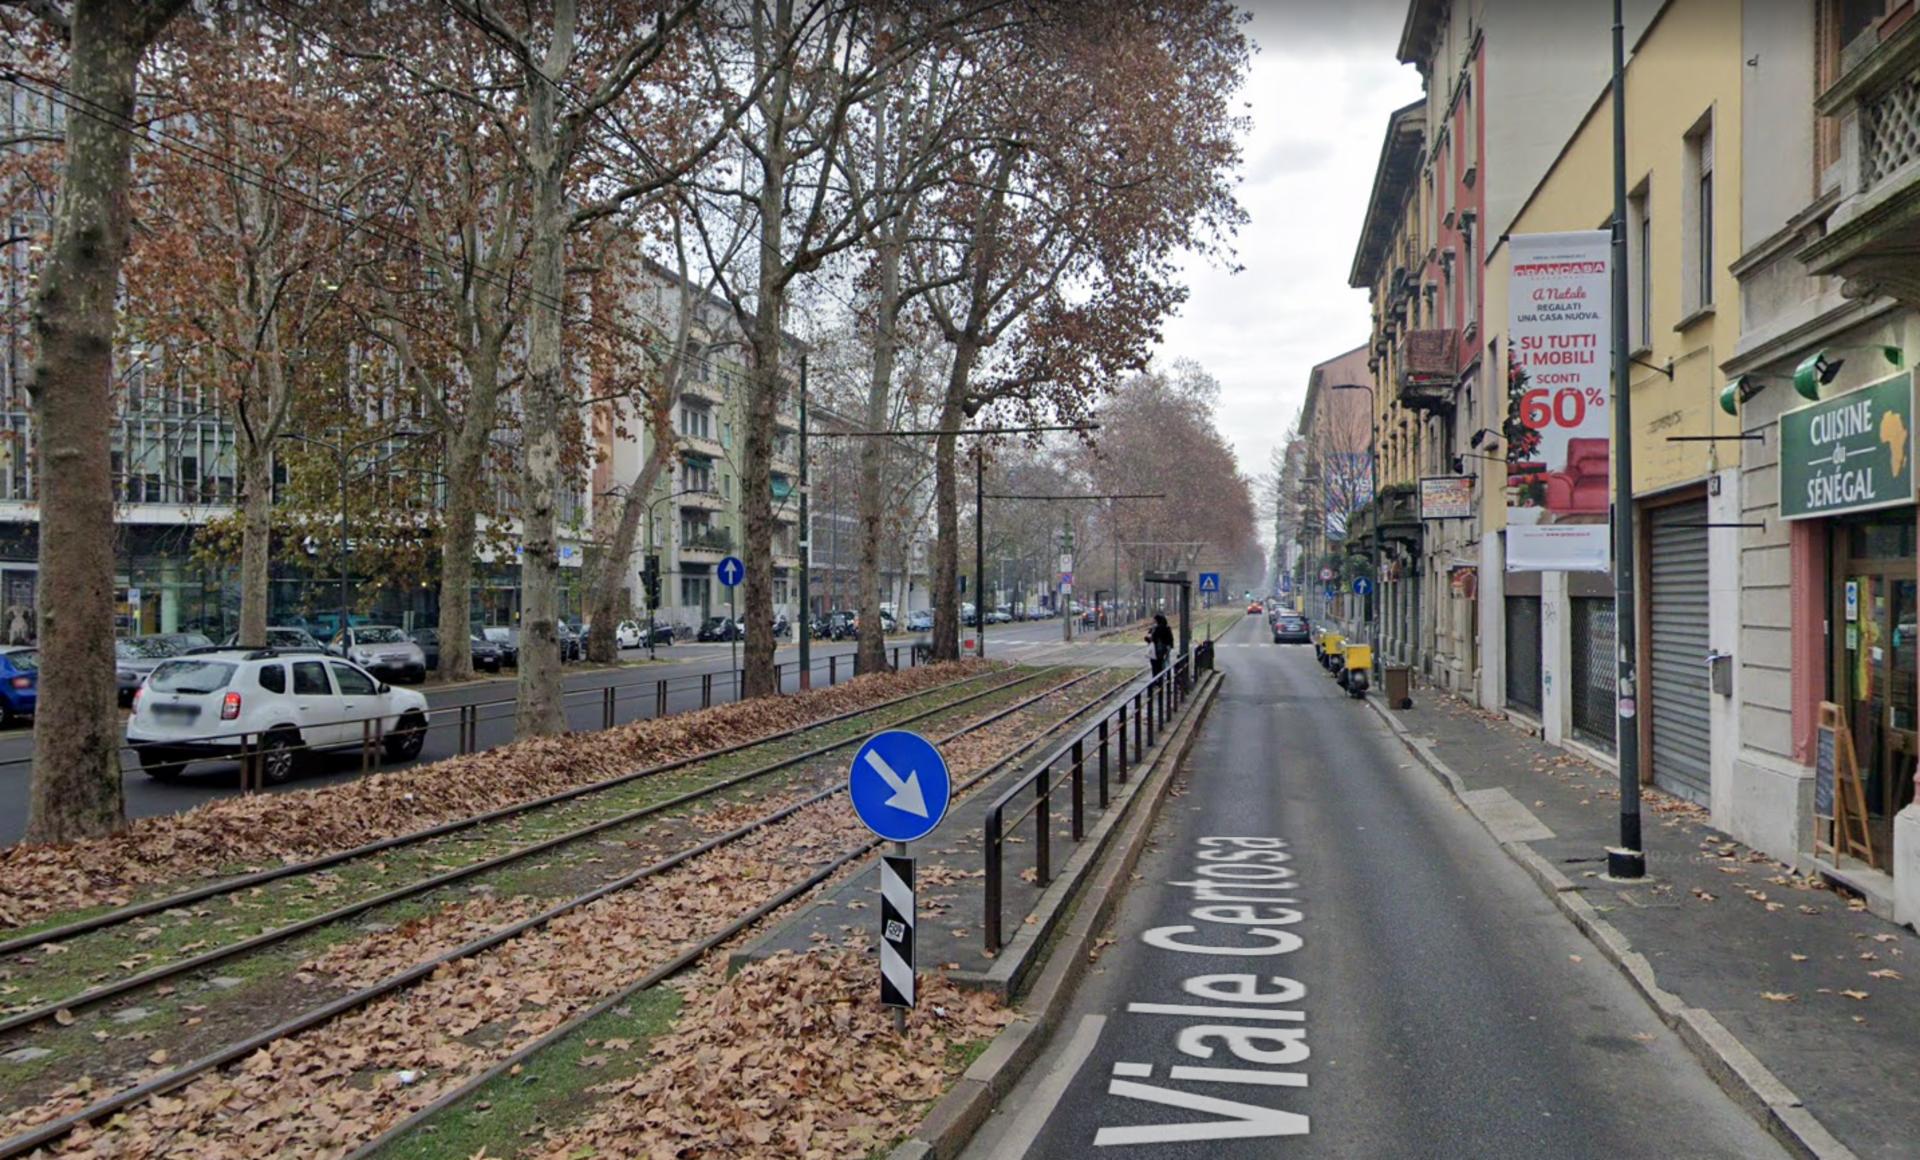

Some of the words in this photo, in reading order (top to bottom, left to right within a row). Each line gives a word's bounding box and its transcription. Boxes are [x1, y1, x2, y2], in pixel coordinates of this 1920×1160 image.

[1533, 288, 1544, 301] A
[1547, 286, 1587, 300] Natale
[1537, 303, 1581, 312] REGALATI
[1517, 314, 1537, 322] UNA
[1540, 313, 1563, 321] CASA
[1521, 336, 1543, 350] SU
[1548, 334, 1596, 348] TUTTI
[1523, 352, 1528, 366] I
[1533, 350, 1594, 365] MOBILI
[1536, 373, 1580, 384] SCONTI
[1520, 387, 1605, 430] 60%
[1810, 399, 1873, 445] CUISINE
[1832, 442, 1846, 464] du
[1806, 466, 1876, 508] SÉNÉGAL
